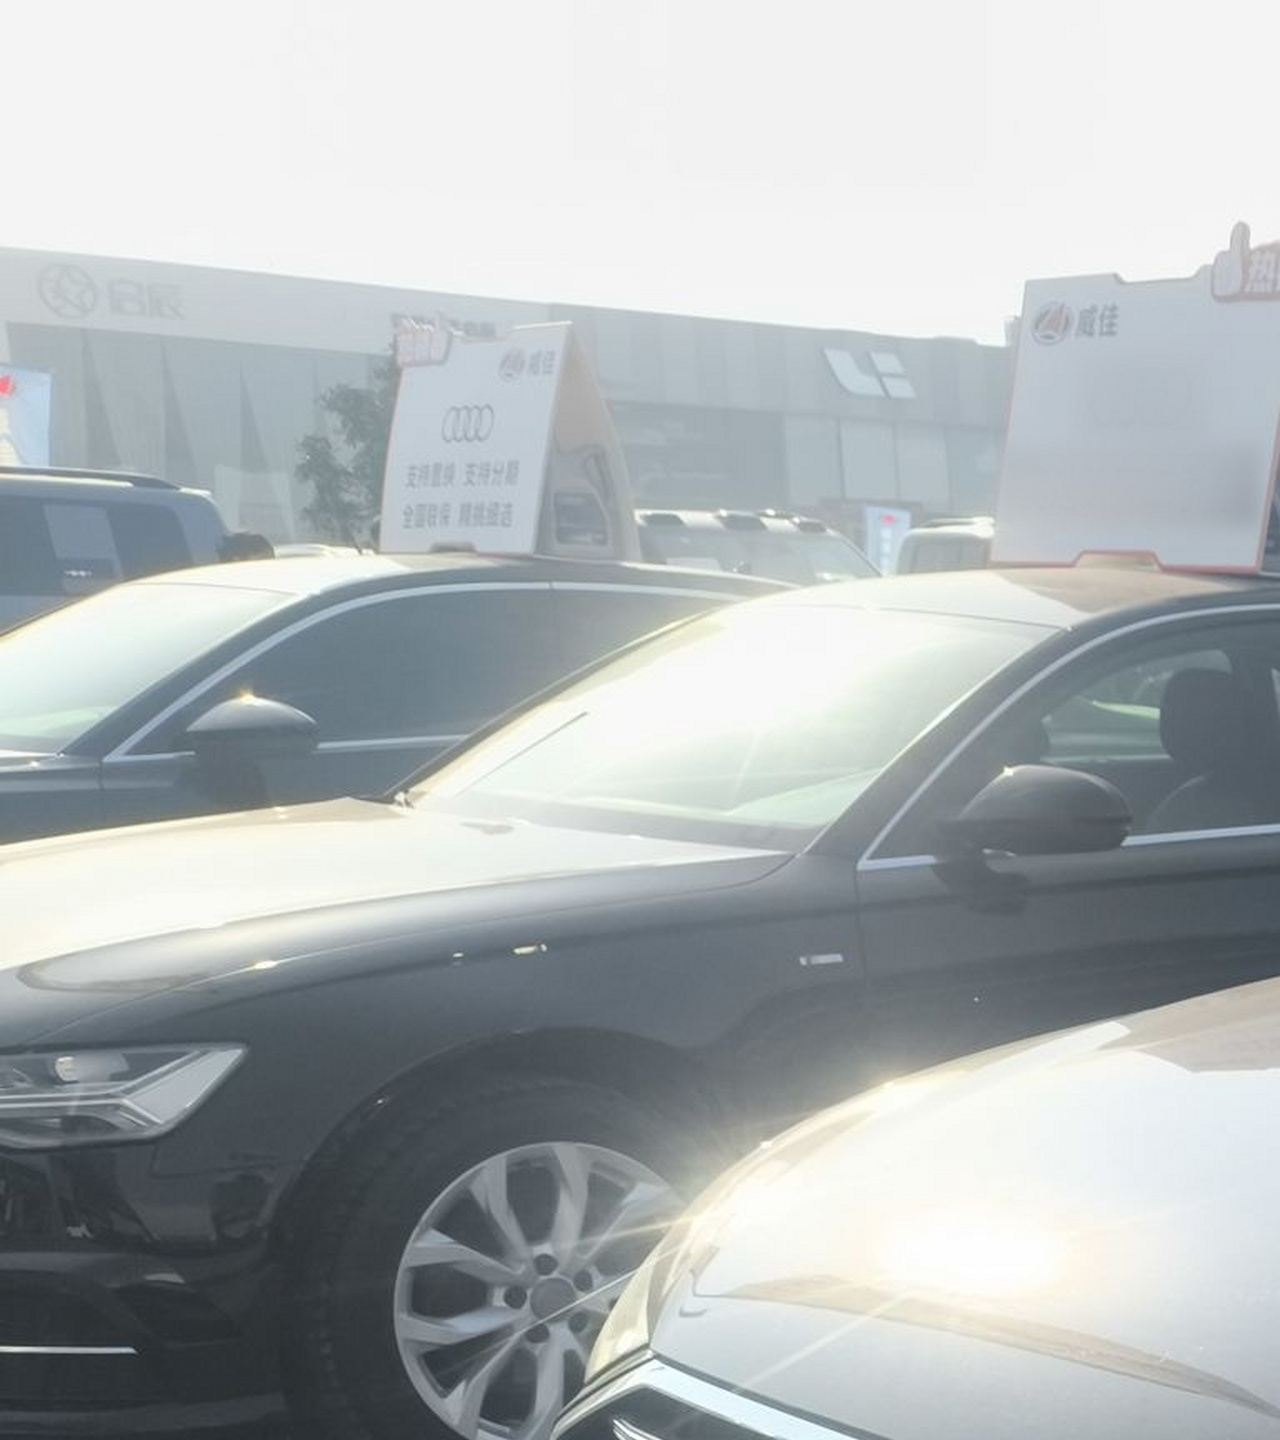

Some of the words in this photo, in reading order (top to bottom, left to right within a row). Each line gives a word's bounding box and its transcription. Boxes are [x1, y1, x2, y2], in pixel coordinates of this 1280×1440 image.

[106, 277, 187, 321] 启辰
[1077, 304, 1120, 337] 威佳
[463, 459, 520, 487] 支持分期
